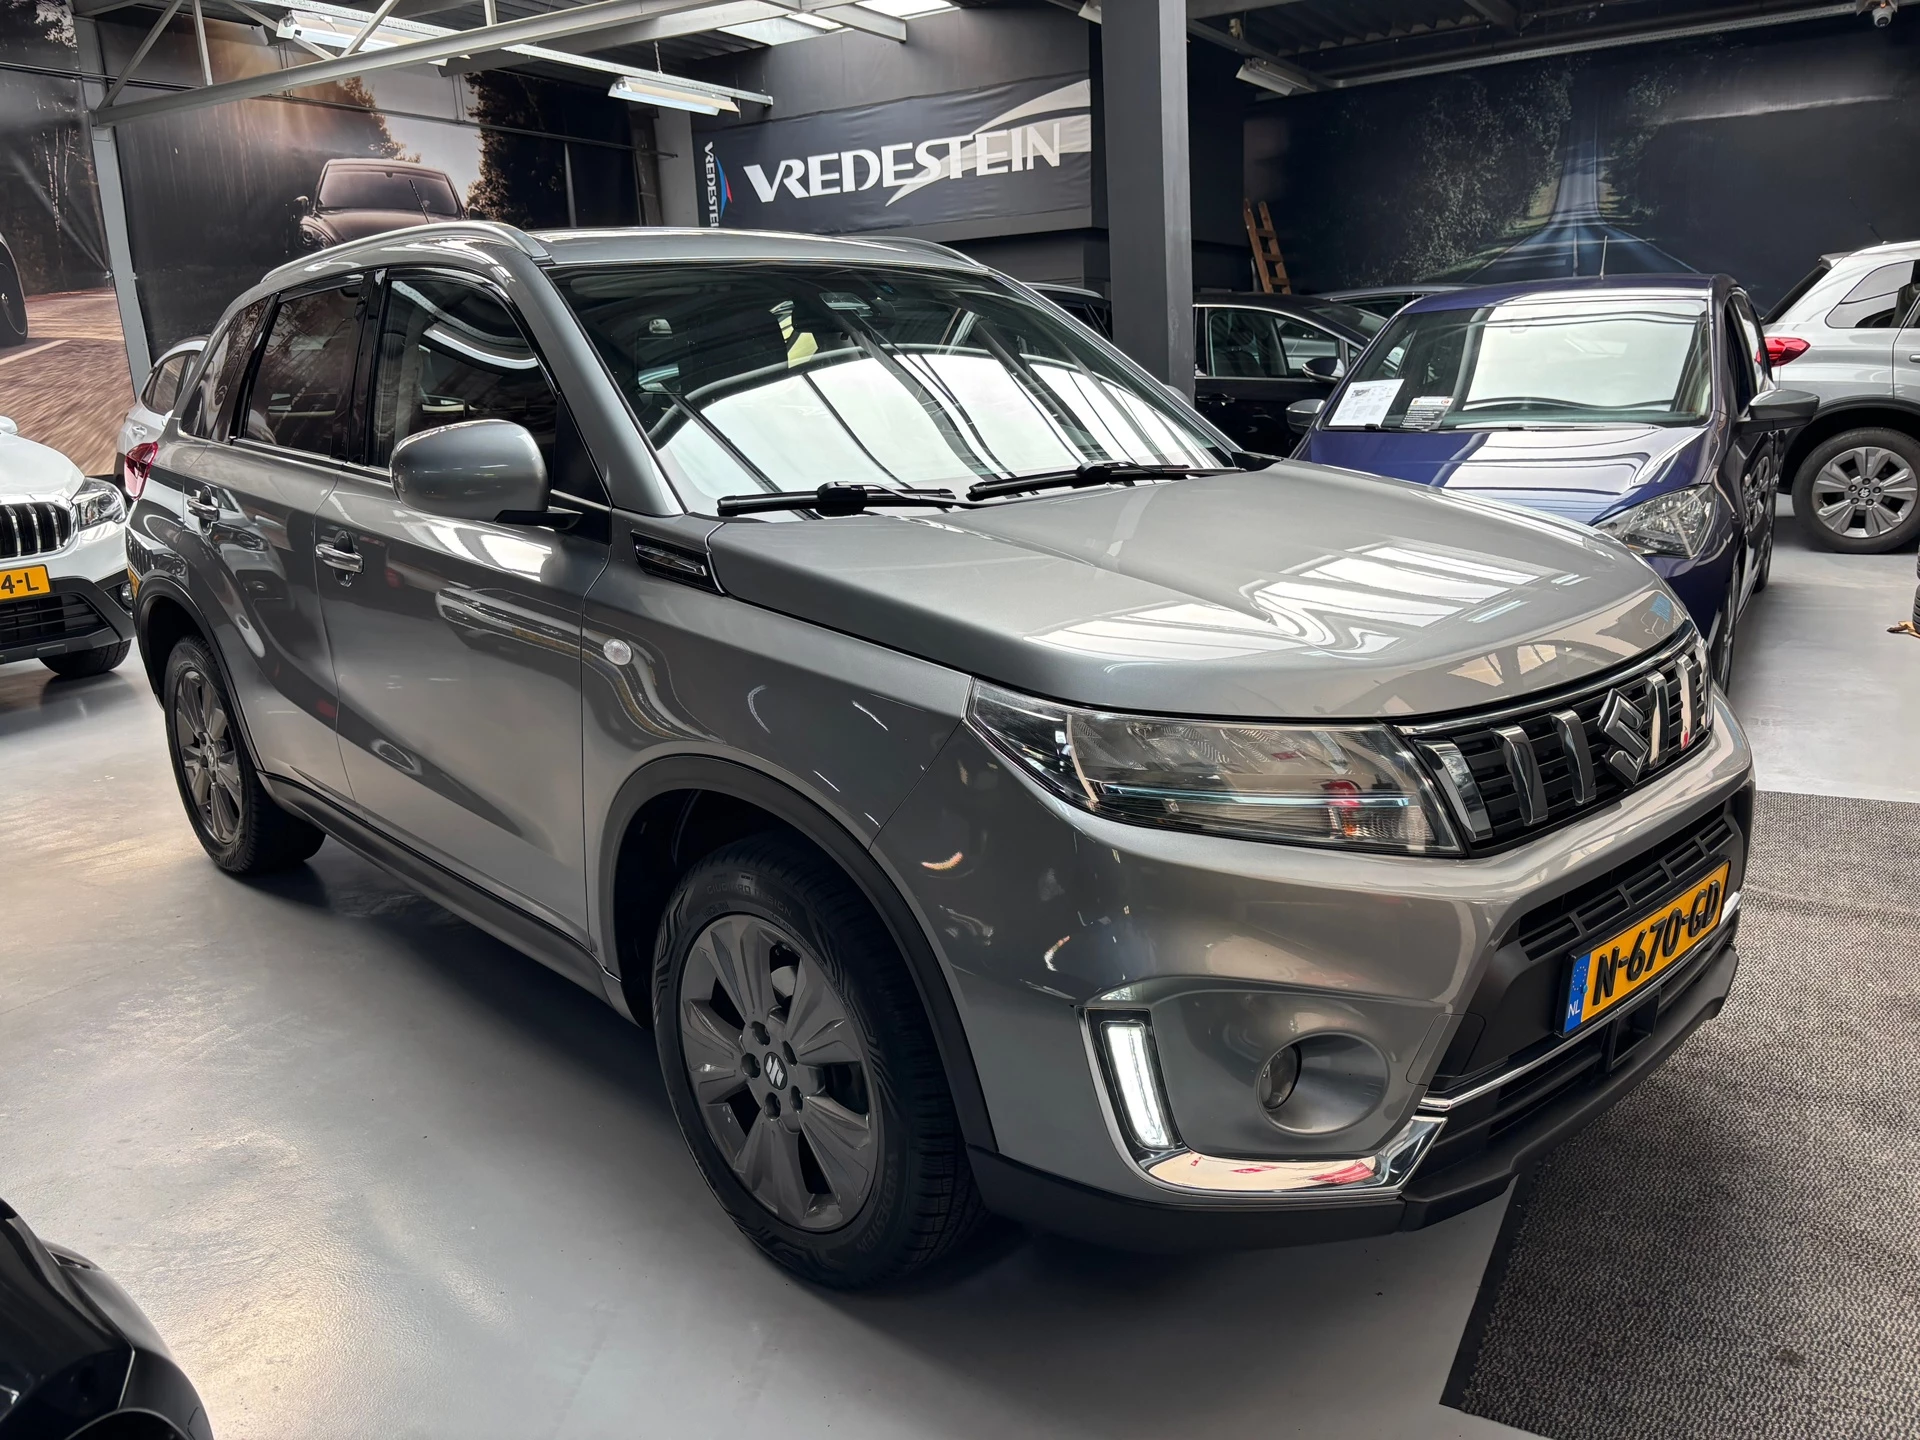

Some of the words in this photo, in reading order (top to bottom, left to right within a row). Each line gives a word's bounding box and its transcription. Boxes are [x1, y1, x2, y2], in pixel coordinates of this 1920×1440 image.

[704, 141, 719, 228] VREDESTEI
[743, 123, 1061, 207] VREDESTEIN
[1592, 880, 1721, 1006] N-670-GD
[1567, 999, 1581, 1019] NL
